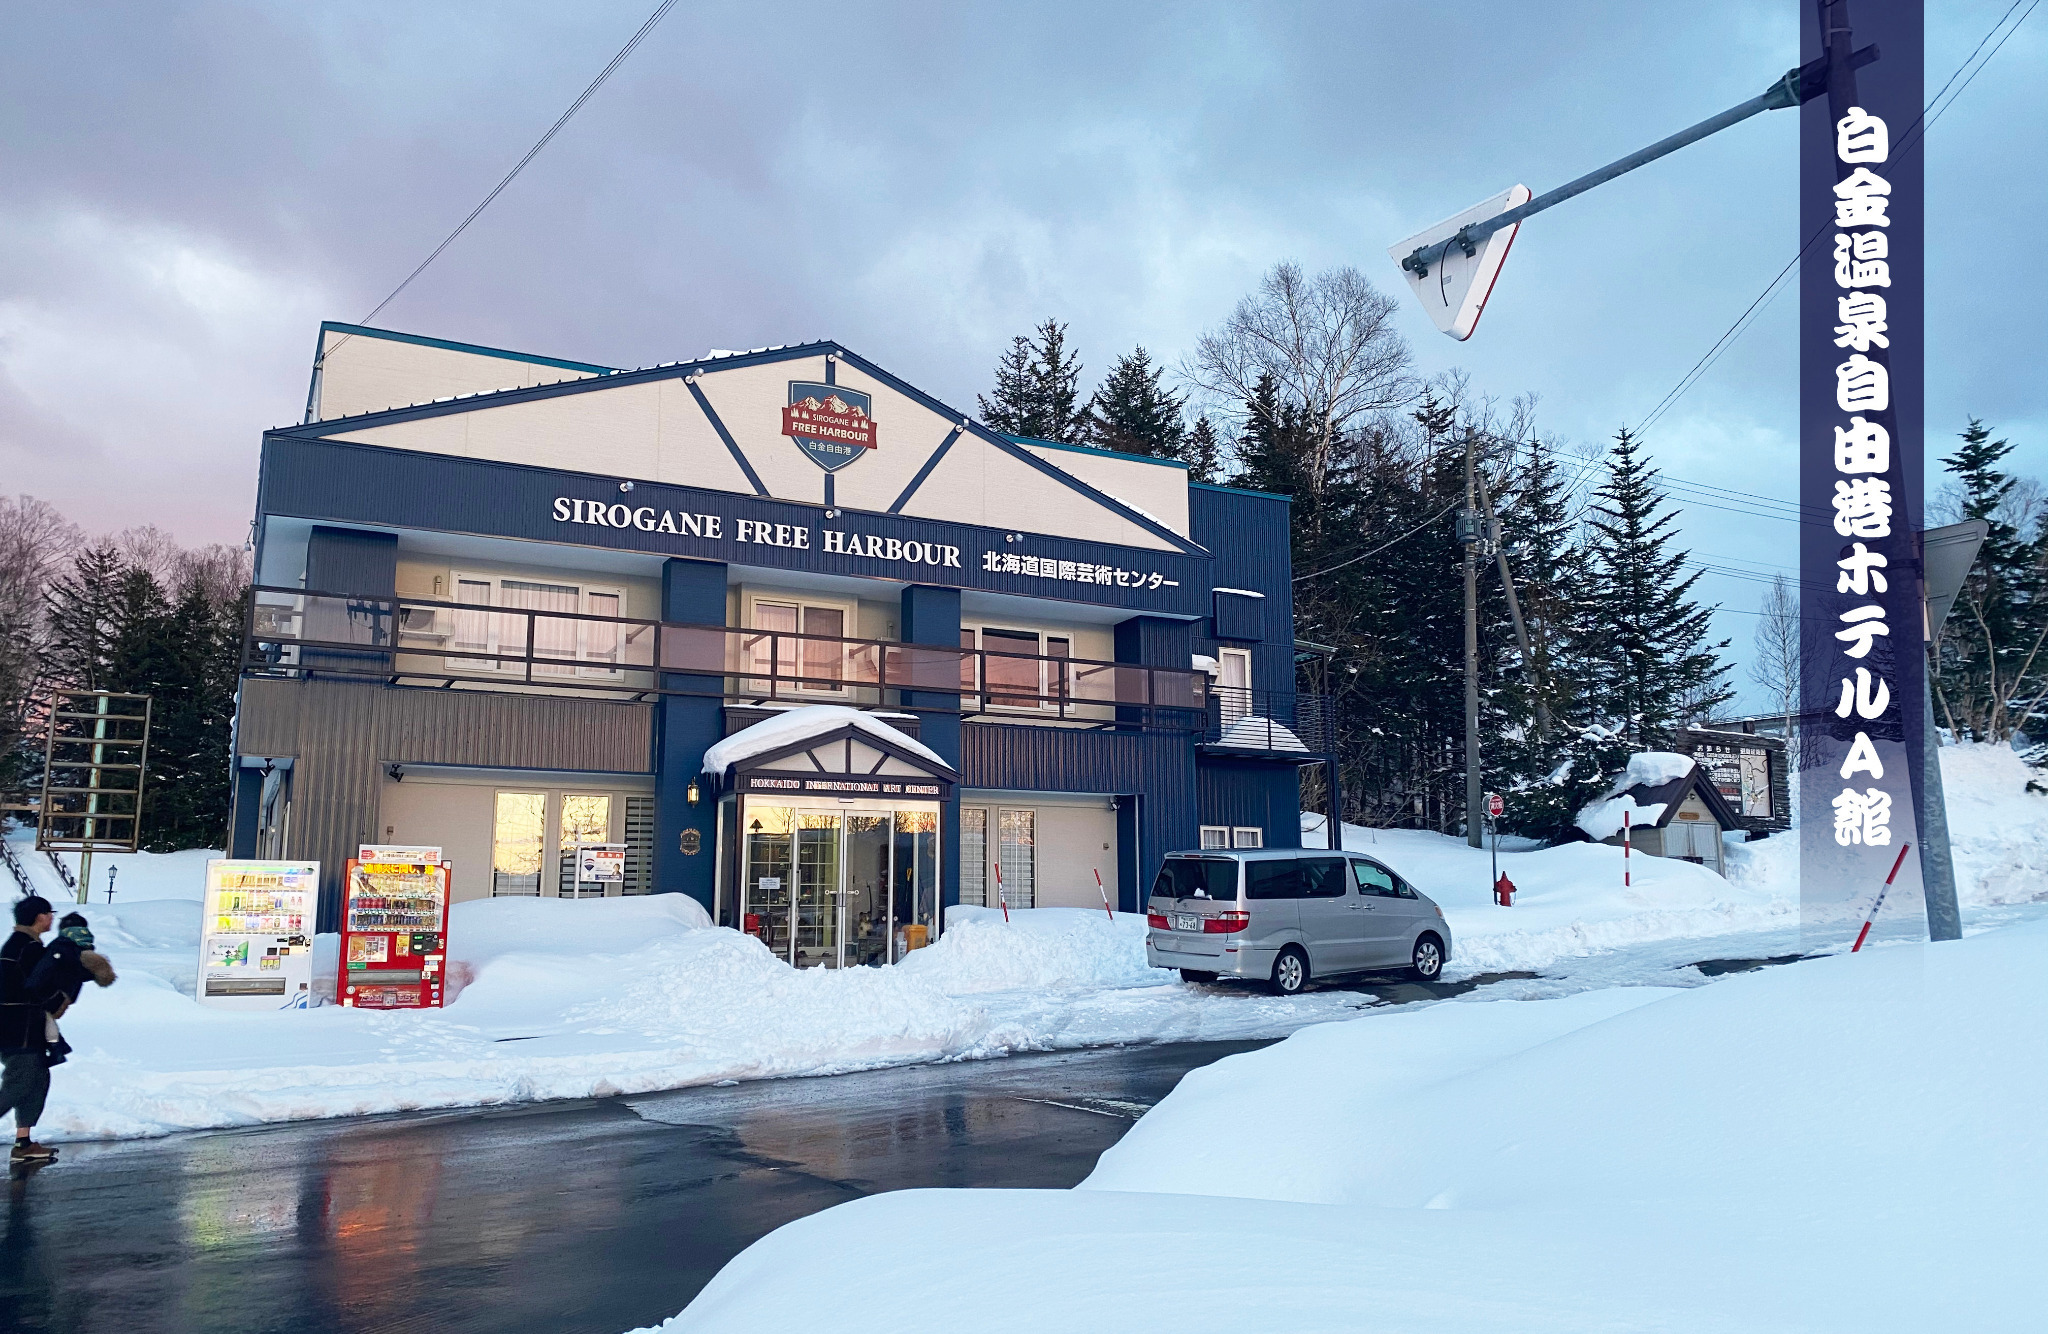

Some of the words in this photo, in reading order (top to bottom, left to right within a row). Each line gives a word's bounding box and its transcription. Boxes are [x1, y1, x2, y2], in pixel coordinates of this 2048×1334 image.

[812, 414, 849, 426] SIROGANE
[792, 422, 817, 434] FREE
[819, 426, 869, 442] HARBOUR
[809, 442, 852, 455] 白金自由港
[553, 496, 723, 539] SIROGANE
[736, 519, 810, 551] FREE
[822, 530, 962, 568] HARBOUR
[982, 550, 1180, 588] 北海道国際芸術センター
[750, 778, 800, 789] HOKKAIDO
[805, 780, 879, 792] INTERNATIONAL
[883, 784, 902, 793] ART
[905, 785, 939, 795] CENTER
